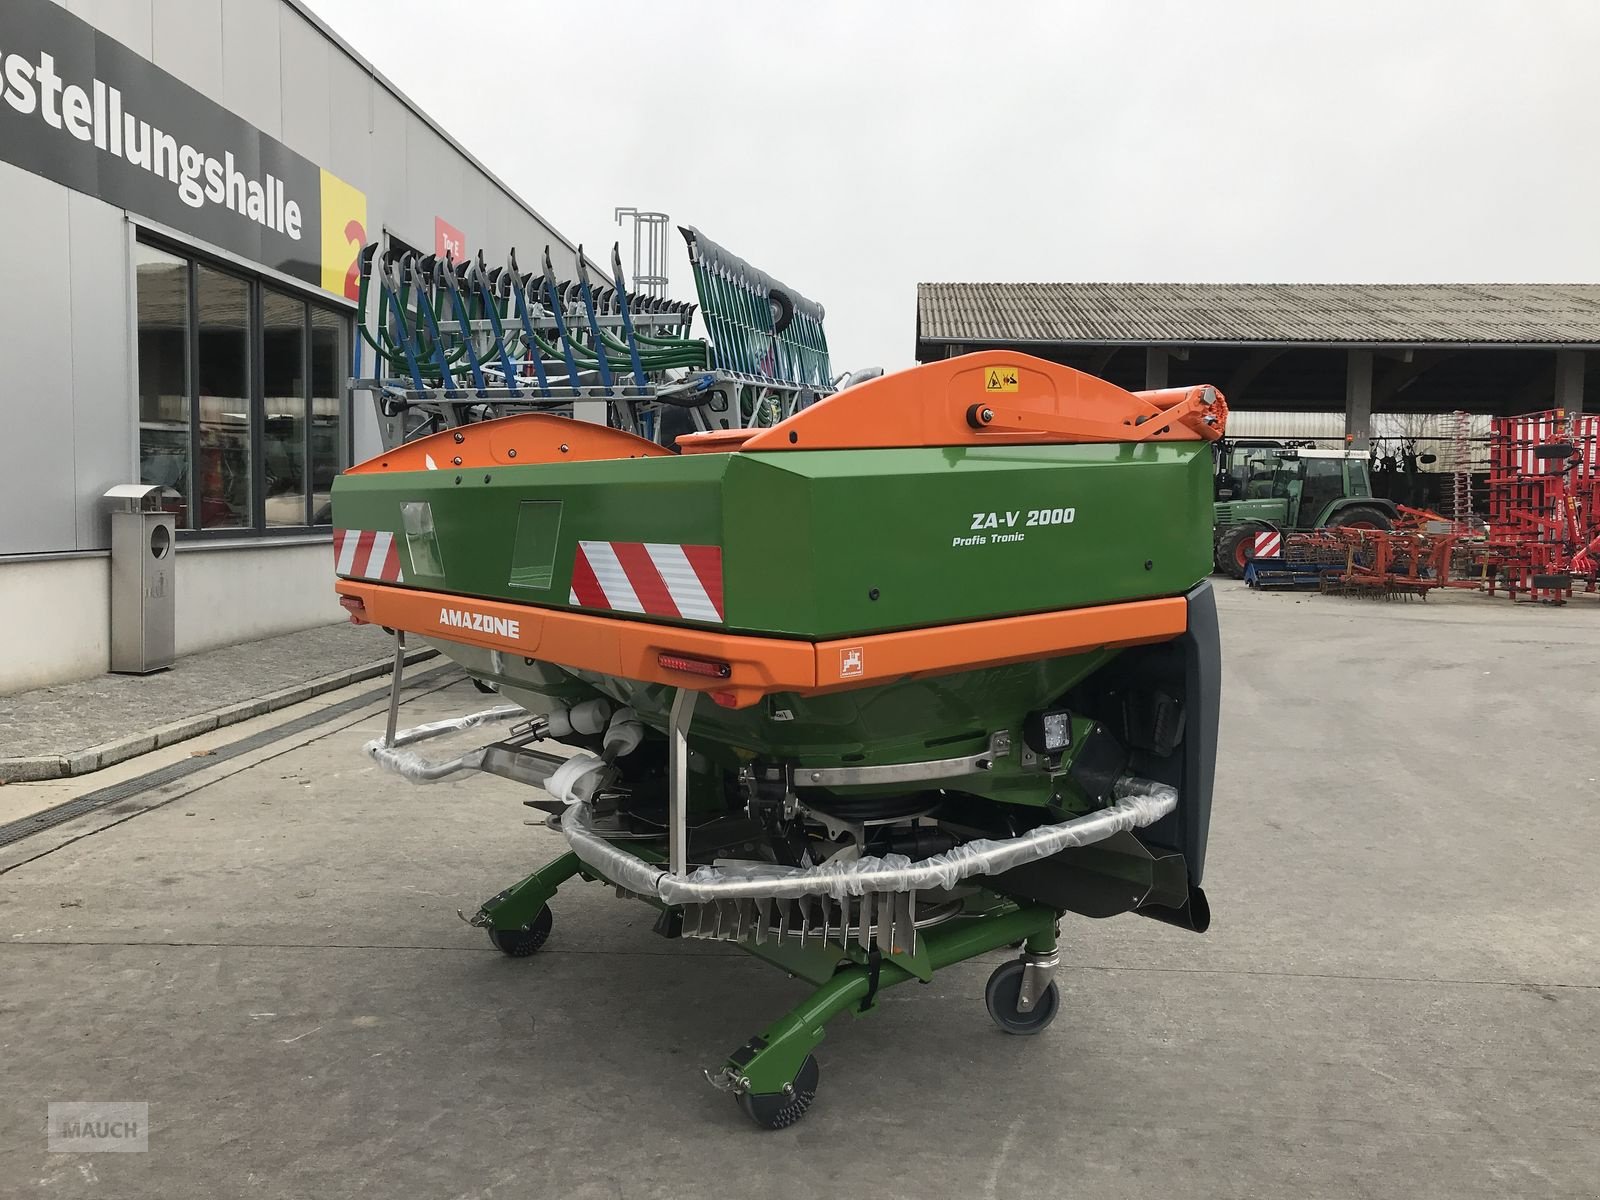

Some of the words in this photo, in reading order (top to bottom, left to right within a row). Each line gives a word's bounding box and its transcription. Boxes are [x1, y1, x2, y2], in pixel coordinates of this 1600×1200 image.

[0, 50, 301, 241] stellungshalle
[970, 510, 1020, 530] ZA-V
[1026, 507, 1075, 526] 2000
[952, 535, 987, 547] Profis
[991, 531, 1025, 543] Tronic
[439, 607, 520, 639] AMAZONE
